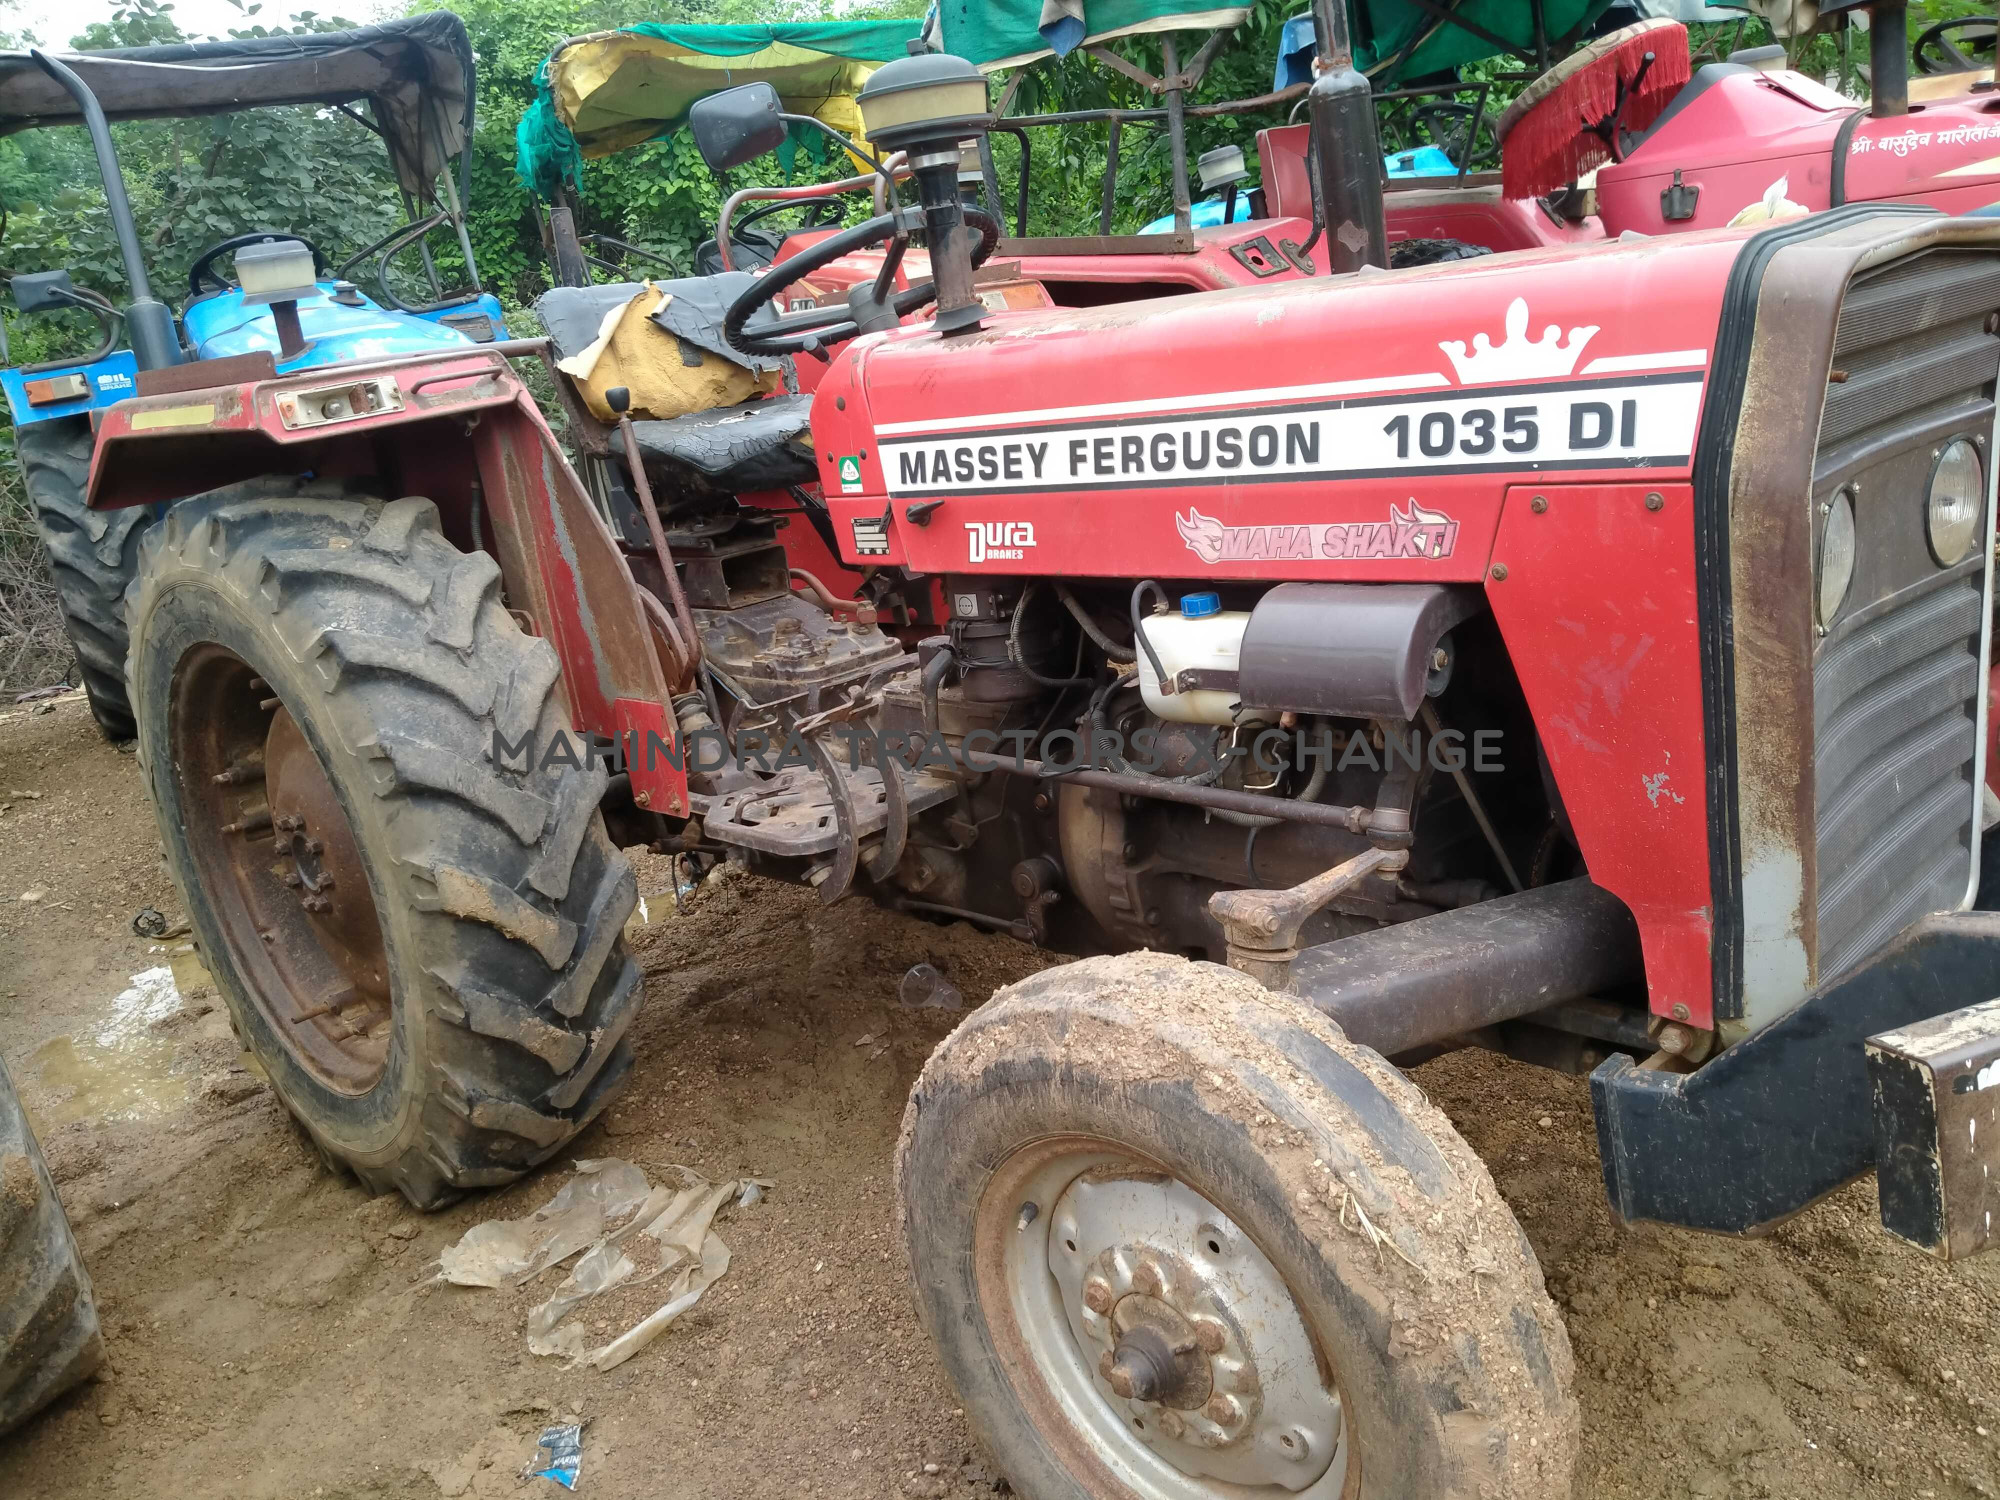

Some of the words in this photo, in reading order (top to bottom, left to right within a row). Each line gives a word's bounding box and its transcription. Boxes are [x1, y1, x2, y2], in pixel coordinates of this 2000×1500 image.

[900, 442, 1048, 485] MASSEY
[1069, 421, 1320, 477] FERGUSON
[1383, 406, 1539, 459] 1035
[1568, 400, 1637, 451] DI
[986, 549, 1024, 560] BRAKES
[1219, 526, 1313, 559] MAHA
[1321, 522, 1459, 558] SHAKTI
